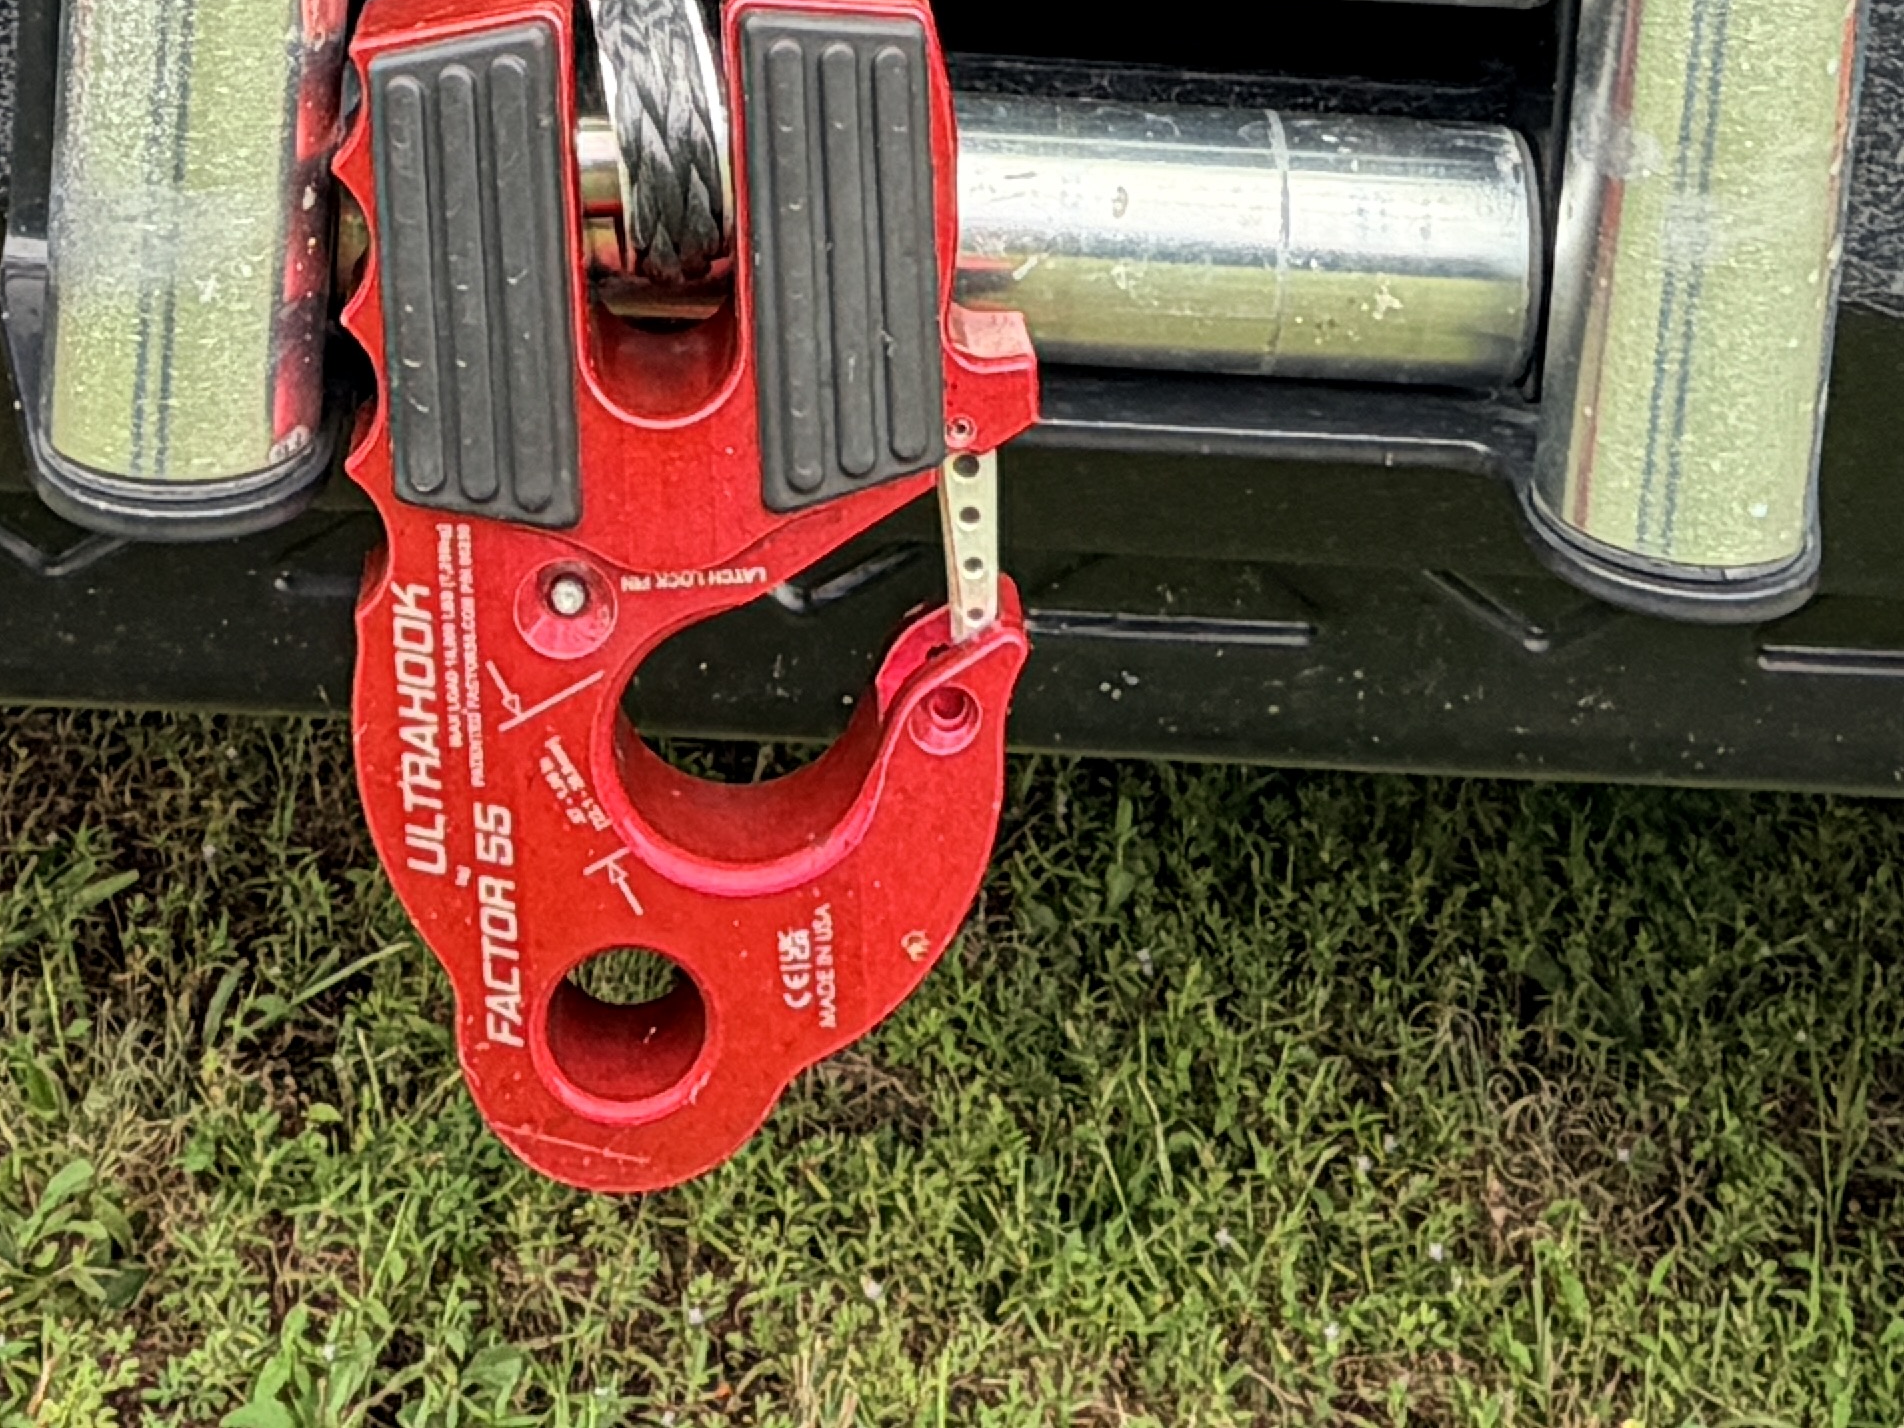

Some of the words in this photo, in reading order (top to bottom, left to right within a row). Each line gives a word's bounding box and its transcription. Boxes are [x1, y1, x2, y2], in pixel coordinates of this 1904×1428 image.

[654, 569, 706, 589] LOCK
[708, 566, 767, 586] LATCH
[392, 581, 447, 877] ULTRAHOOK
[473, 800, 514, 868] 55
[811, 902, 834, 943] USA
[478, 874, 524, 1049] FACTOR
[814, 944, 834, 967] IN
[815, 968, 837, 1029] MADE
